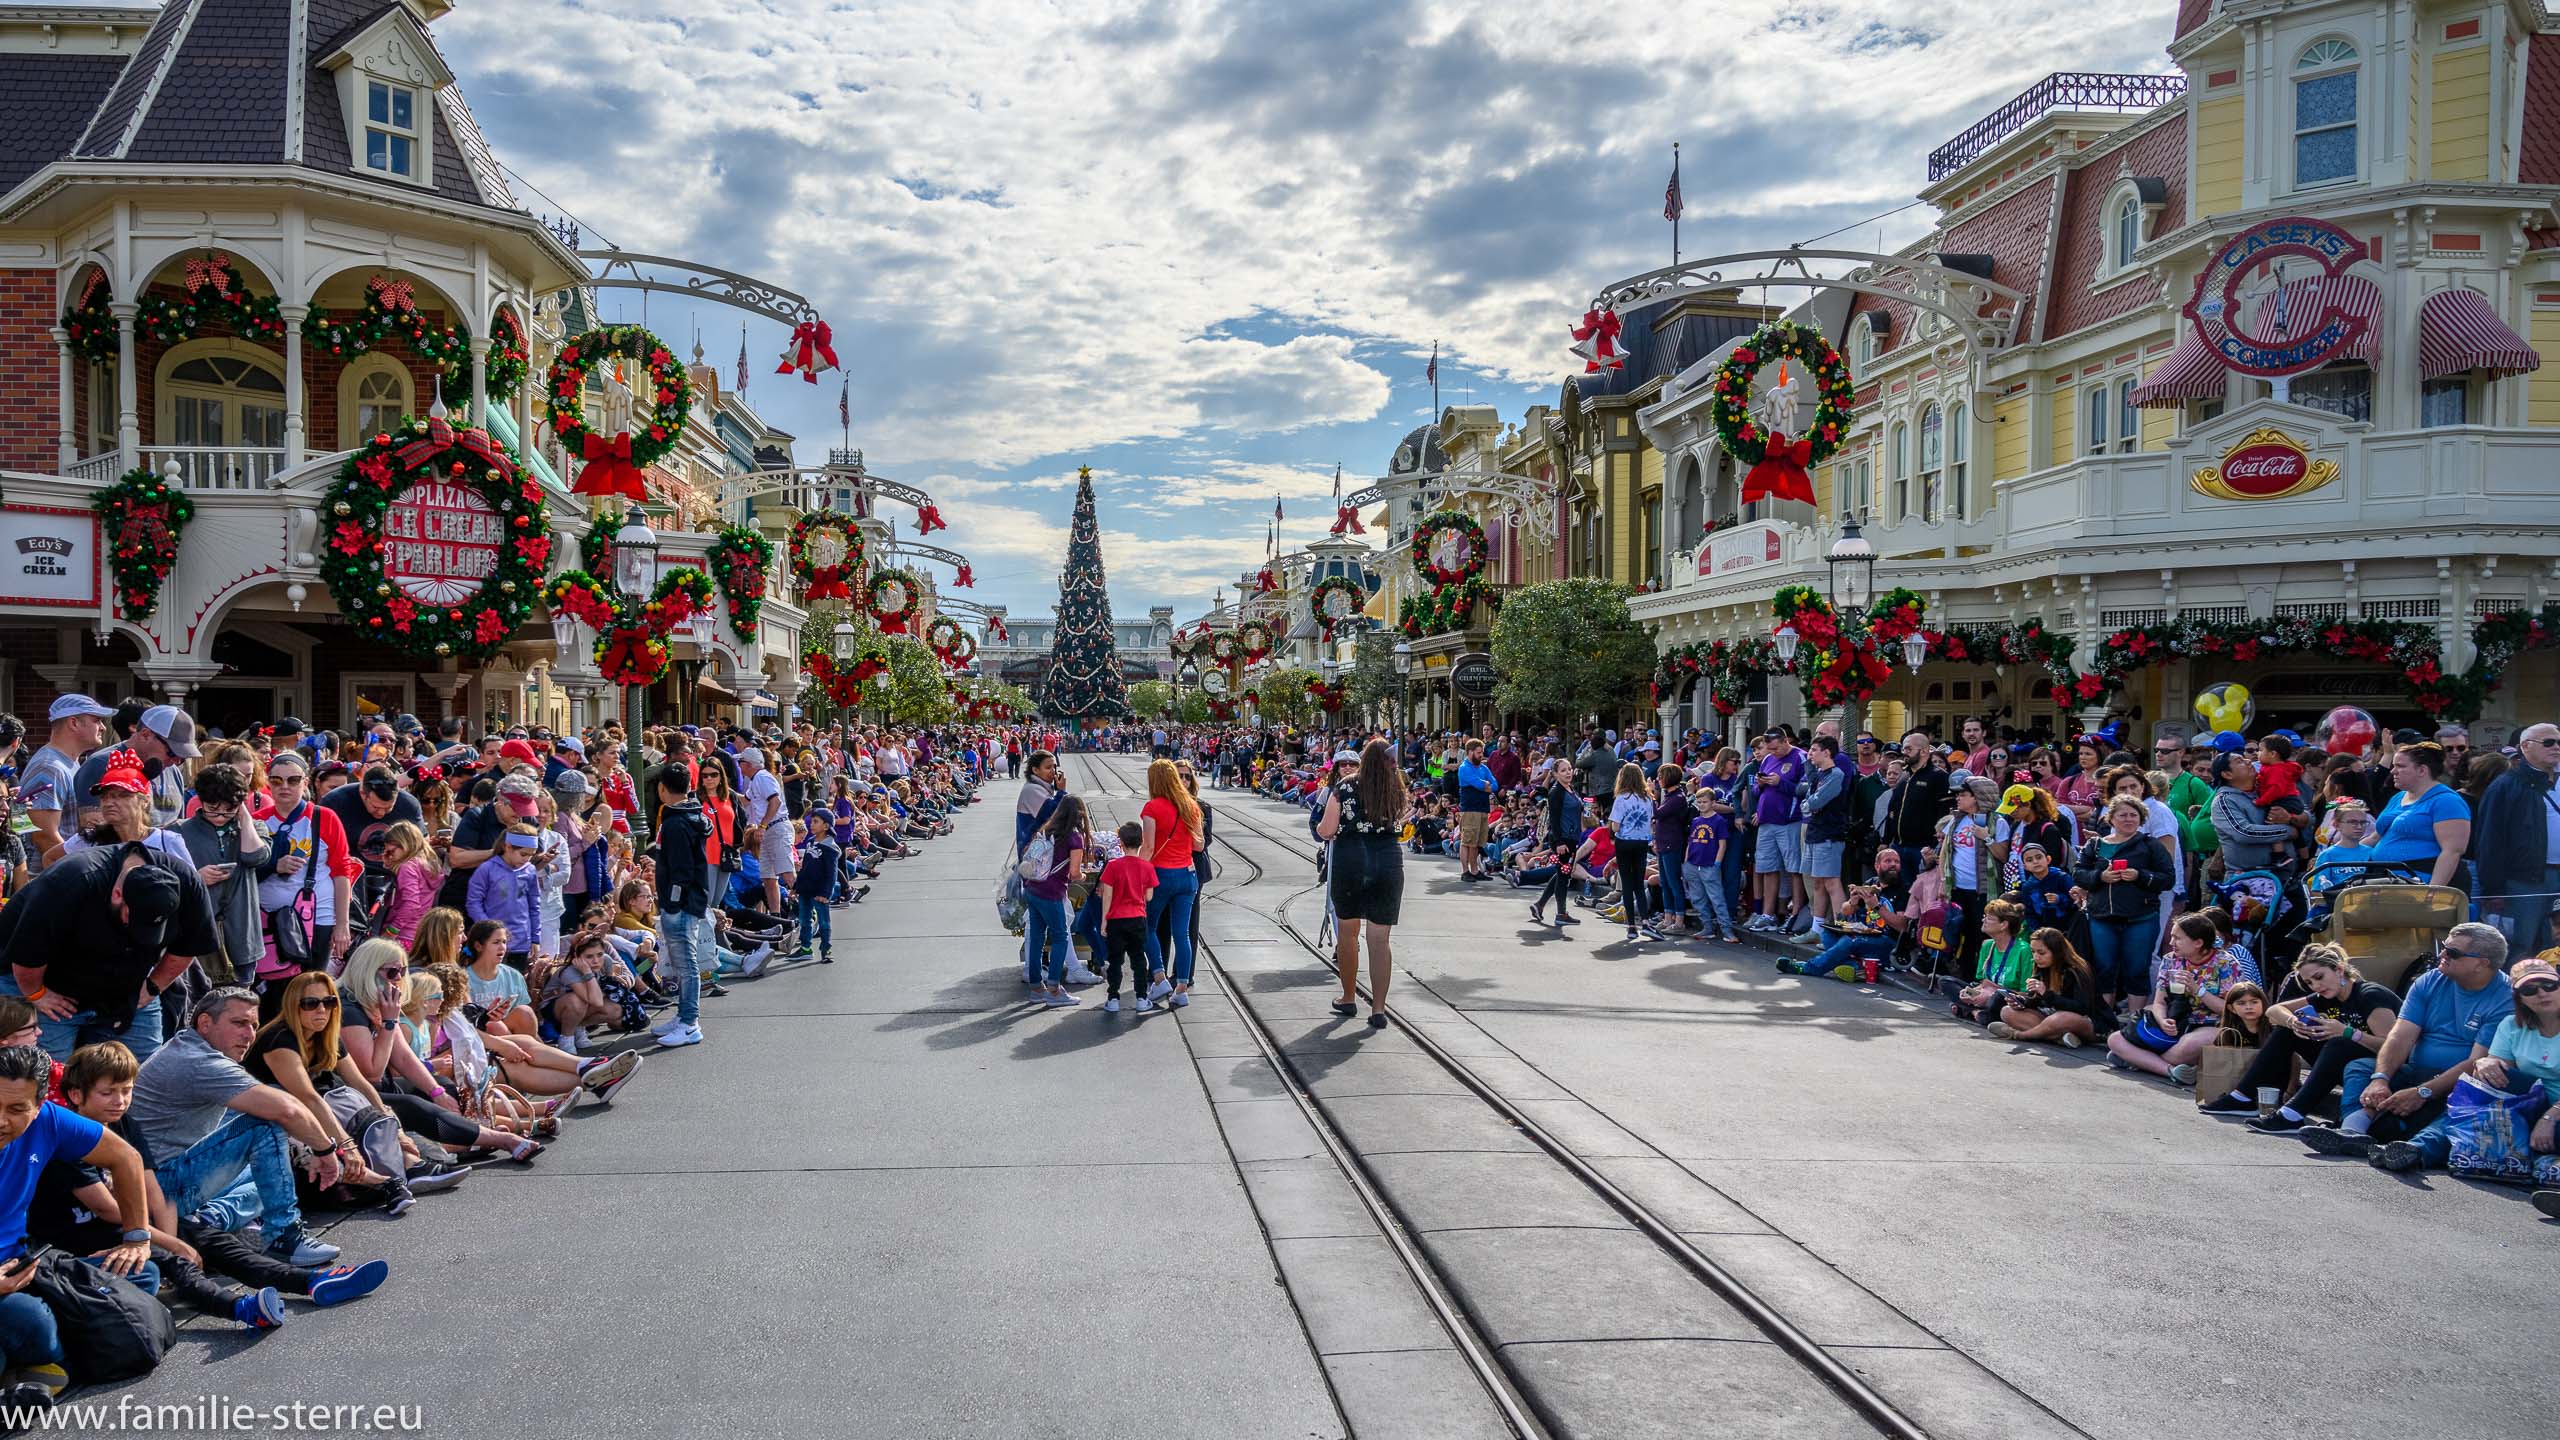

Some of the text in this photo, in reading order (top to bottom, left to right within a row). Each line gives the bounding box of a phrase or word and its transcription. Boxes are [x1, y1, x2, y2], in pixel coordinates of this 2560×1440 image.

[2219, 324, 2345, 368] CORNER
[2226, 455, 2298, 480] Coca-Cola
[416, 484, 465, 509] PLAZA
[424, 509, 505, 546] CREAM
[28, 538, 63, 551] Edy's
[23, 565, 67, 576] CREAM
[35, 556, 55, 565] ICE
[395, 541, 491, 578] PARLOR
[856, 568, 864, 604] CRYSTAL
